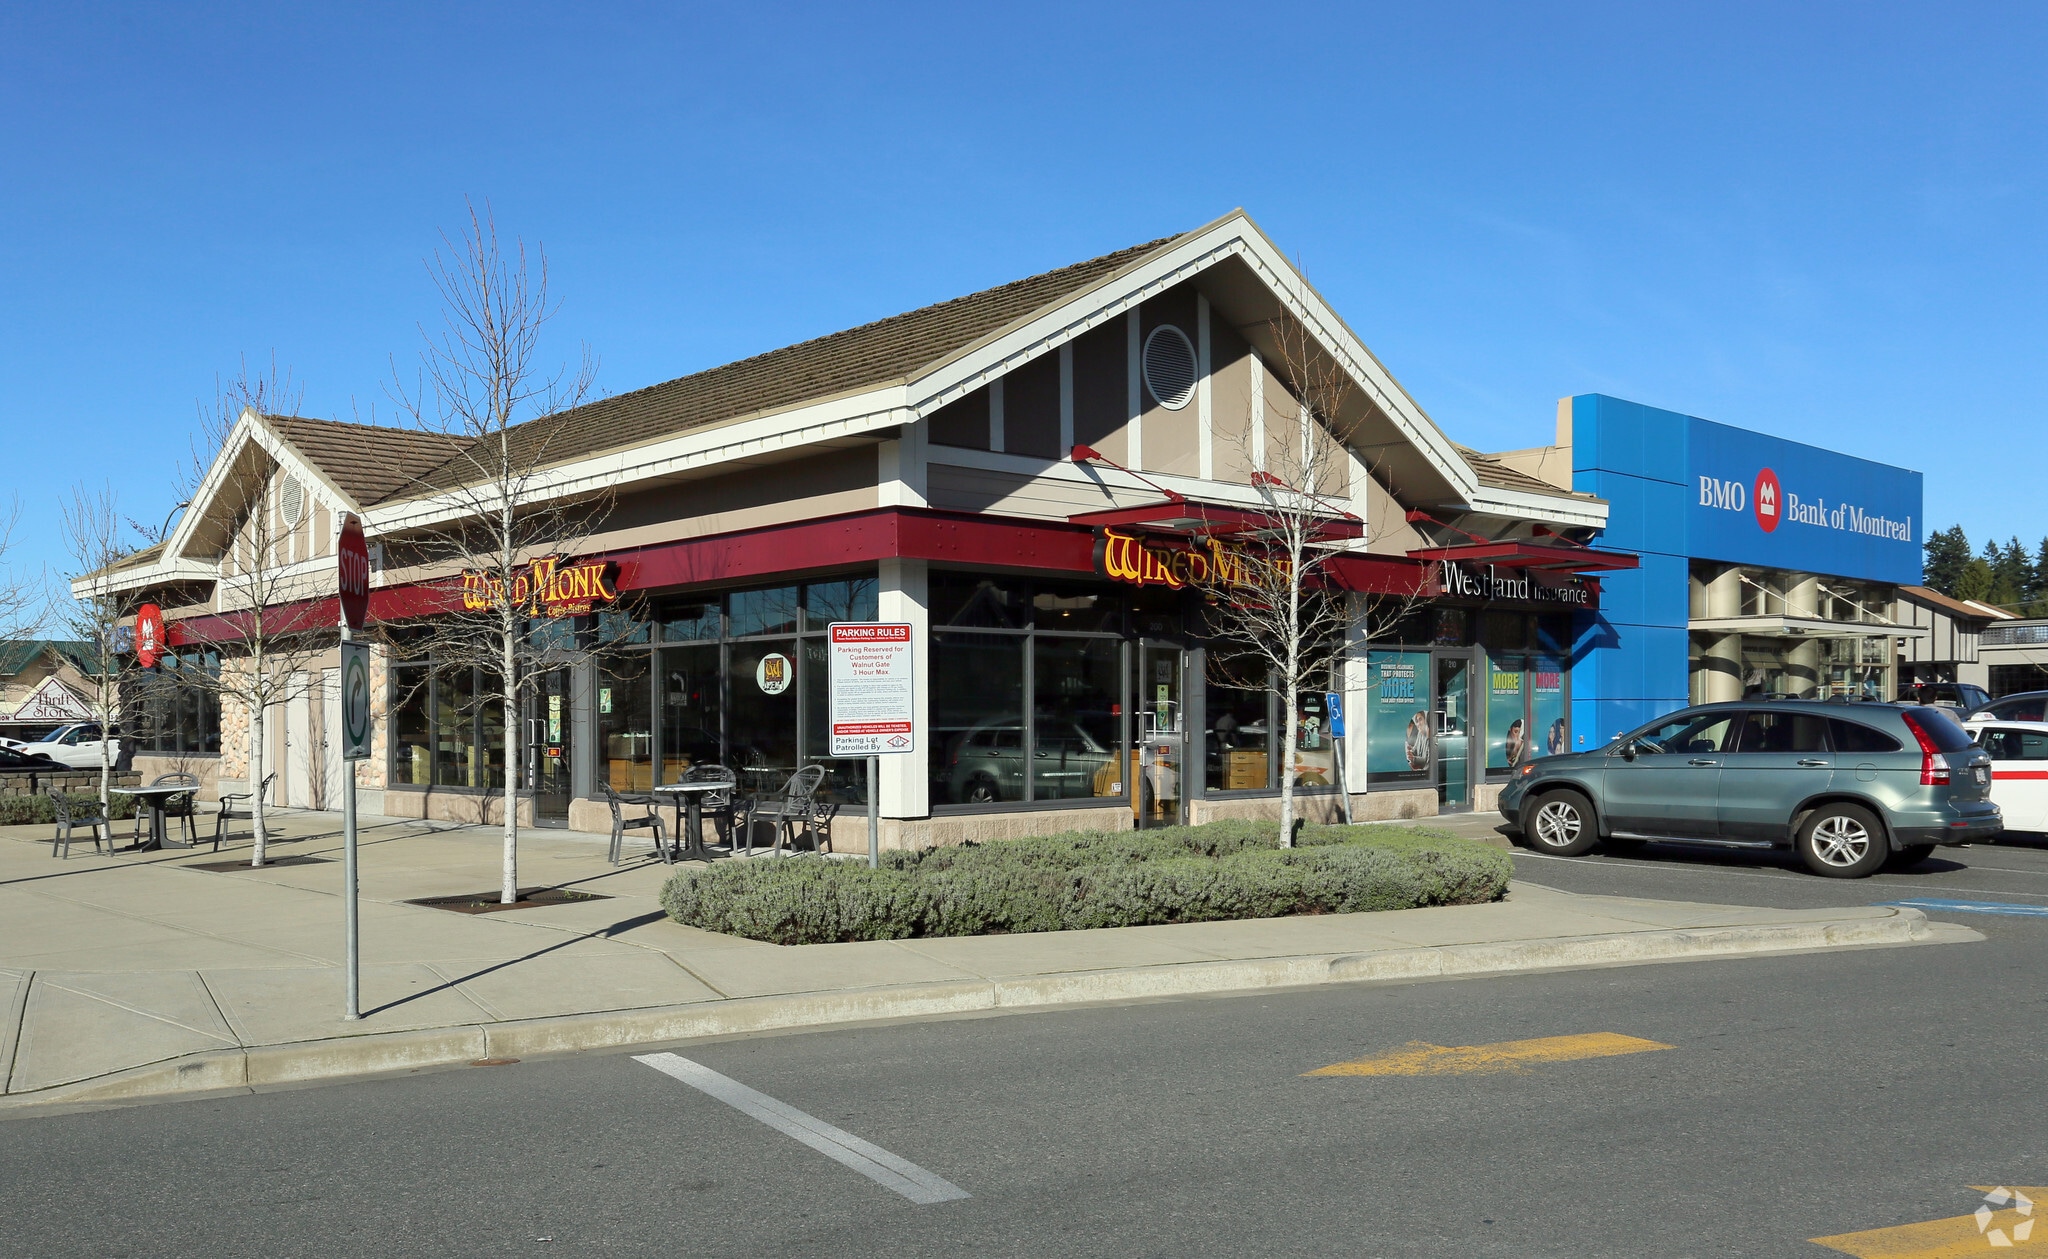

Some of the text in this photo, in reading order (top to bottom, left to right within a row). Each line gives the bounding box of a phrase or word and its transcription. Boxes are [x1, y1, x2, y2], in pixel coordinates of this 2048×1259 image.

[1699, 476, 1912, 542] BMO Bank of Montreal
[340, 547, 367, 596] STOP
[1443, 560, 1528, 600] Westland
[836, 628, 906, 637] PARKING RULES
[1381, 678, 1414, 698] MORE
[1493, 674, 1519, 689] MORE
[1536, 672, 1560, 688] MORE
[38, 693, 72, 705] Thrift
[33, 706, 73, 718] Store
